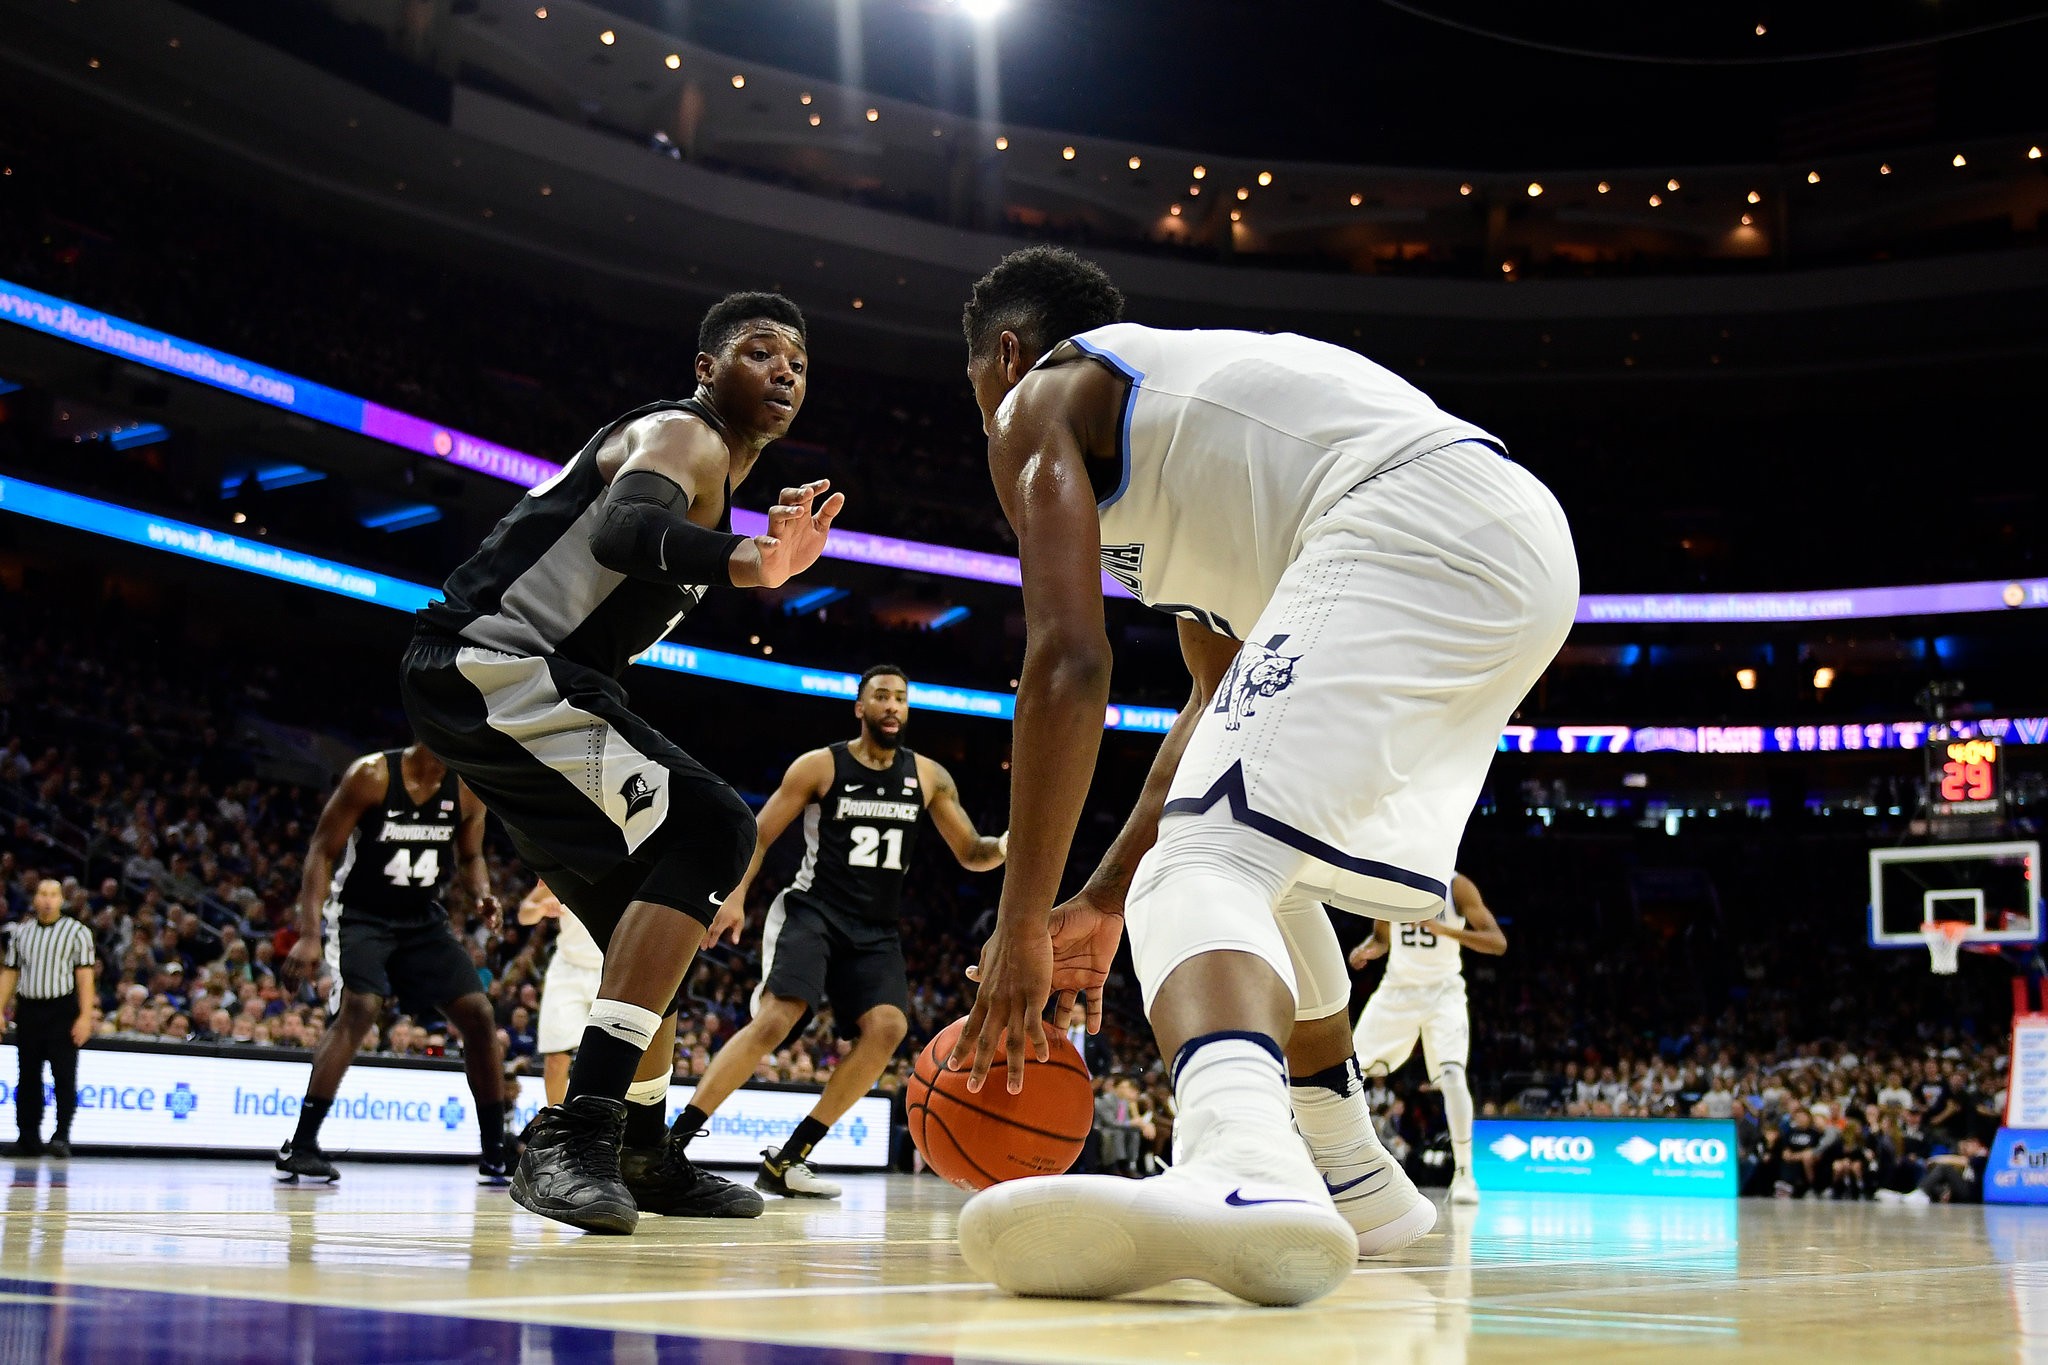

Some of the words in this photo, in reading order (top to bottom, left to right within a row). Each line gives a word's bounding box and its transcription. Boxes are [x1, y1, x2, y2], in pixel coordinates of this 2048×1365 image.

[1941, 761, 1992, 801] 29
[833, 796, 920, 822] PROVIDENCE
[376, 820, 456, 842] PROVIDENCE
[848, 825, 904, 870] 21
[383, 848, 440, 887] 44
[1400, 921, 1438, 948] 25
[1530, 1136, 1595, 1162] PECO
[1659, 1138, 1728, 1165] PECO
